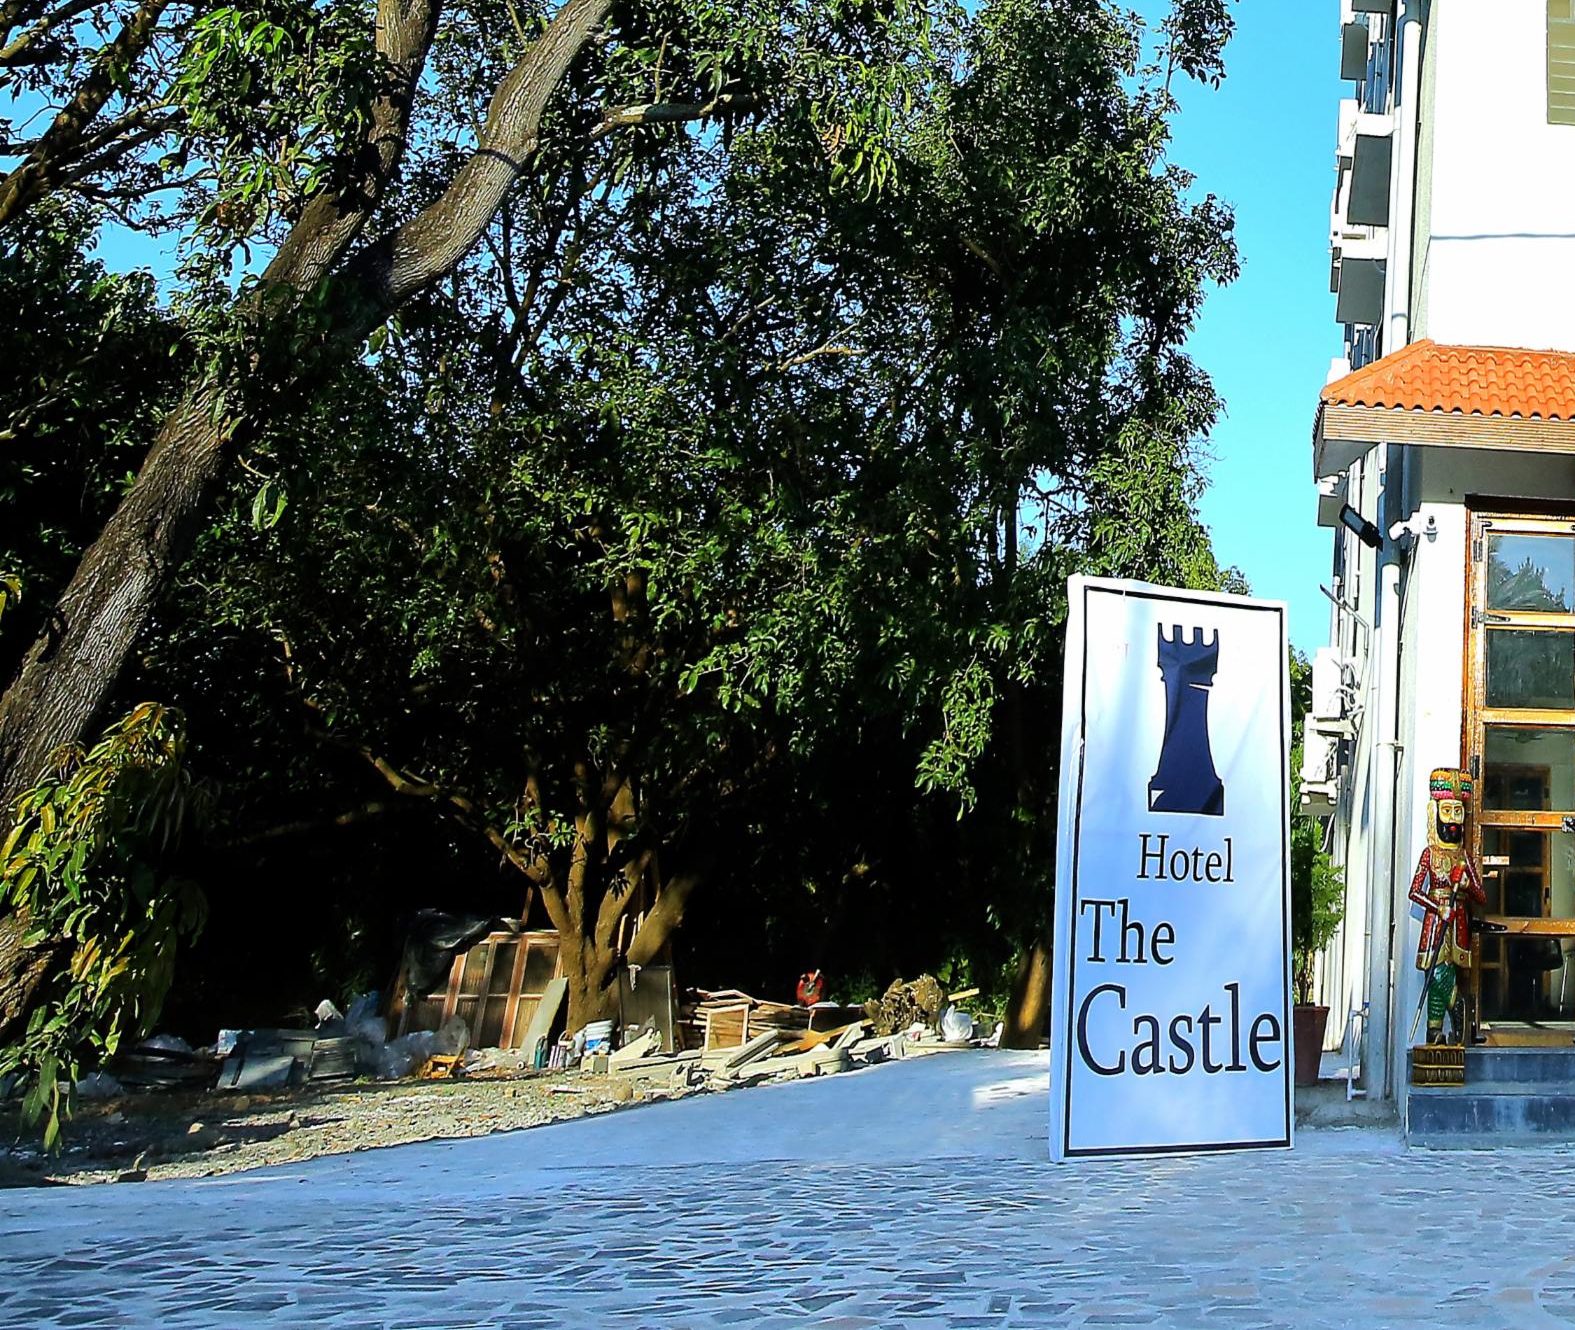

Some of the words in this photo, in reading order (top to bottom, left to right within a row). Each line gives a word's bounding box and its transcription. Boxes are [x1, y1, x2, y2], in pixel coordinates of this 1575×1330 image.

[1136, 833, 1234, 883] Hotel
[1080, 898, 1175, 965] The
[1076, 982, 1281, 1076] Castle
